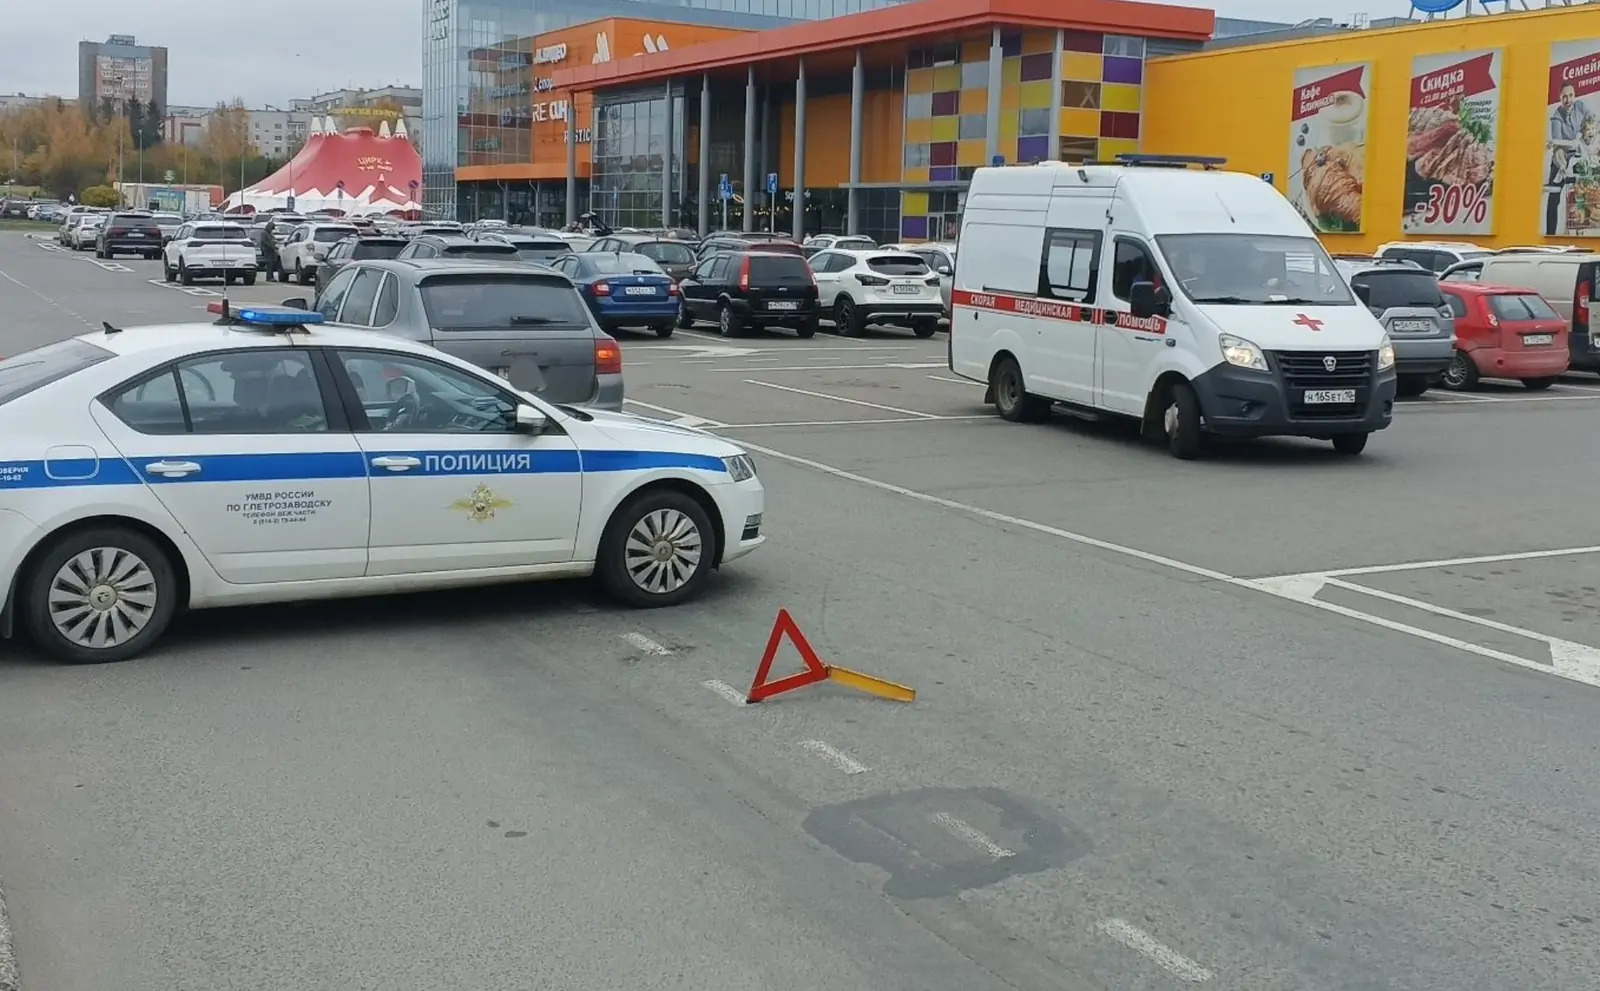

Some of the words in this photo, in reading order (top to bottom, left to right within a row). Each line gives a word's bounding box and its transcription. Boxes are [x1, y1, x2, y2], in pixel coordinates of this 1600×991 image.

[1420, 69, 1464, 93] Скидка
[1301, 85, 1321, 100] Кафе
[1300, 95, 1334, 114] Блинная
[357, 156, 383, 165] ЦИРК
[1415, 182, 1489, 225] -30%
[970, 293, 997, 308] СКОРАЯ
[1014, 299, 1073, 319] МЕДИЦИНСКАЯ
[1119, 313, 1162, 333] ПОМОЩЬ
[425, 454, 530, 472] ПОЛИЦИЯ
[246, 493, 272, 501] УМВД
[274, 491, 314, 500] РОССИИ
[227, 504, 241, 512] ПО
